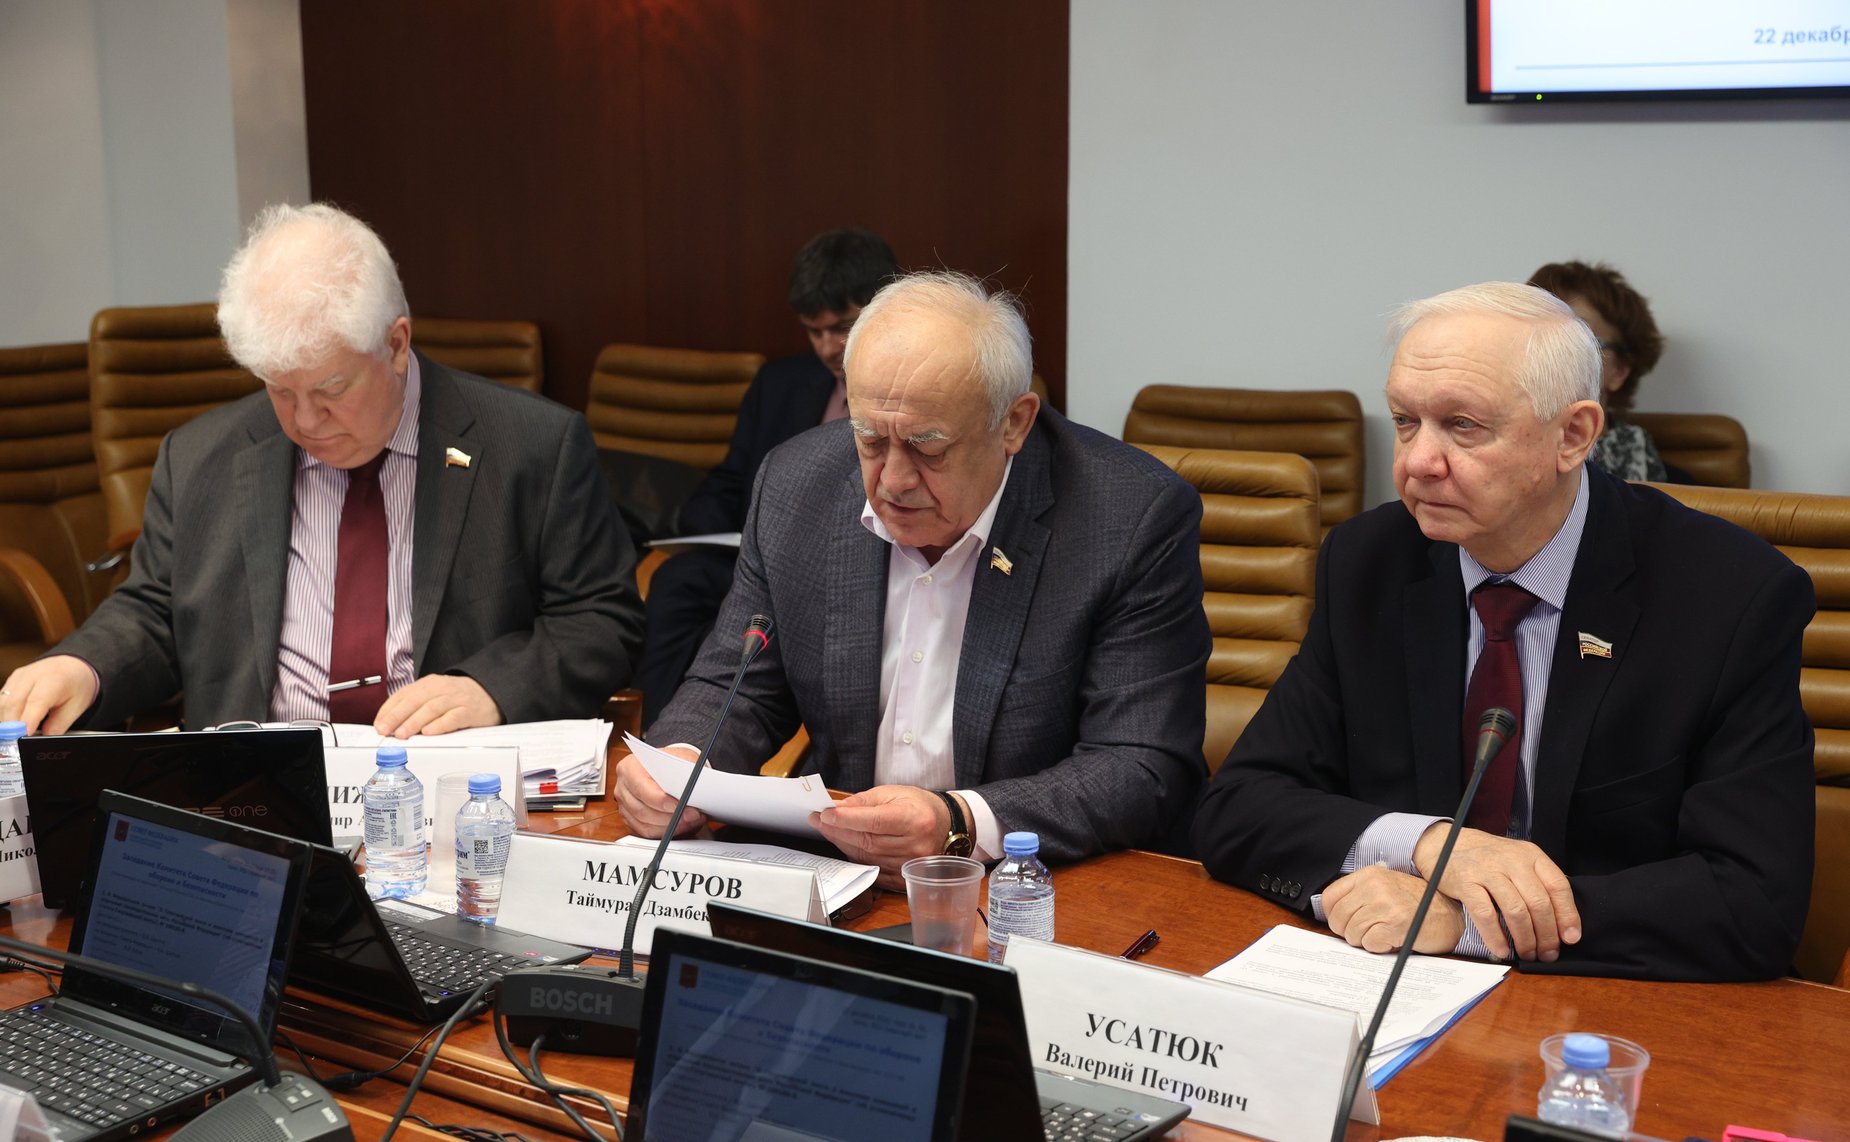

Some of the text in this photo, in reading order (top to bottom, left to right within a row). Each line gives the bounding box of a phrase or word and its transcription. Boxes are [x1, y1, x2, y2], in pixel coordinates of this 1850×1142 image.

[1754, 28, 1776, 44] 22
[36, 751, 71, 761] acer
[188, 870, 211, 884] Совета
[582, 860, 742, 899] МАМСУРОВ
[567, 889, 632, 913] Таймура
[530, 986, 613, 1015] BOSCH
[1085, 1012, 1223, 1069] УСАТЮК
[1045, 1042, 1248, 1112] Валерий Петрович
